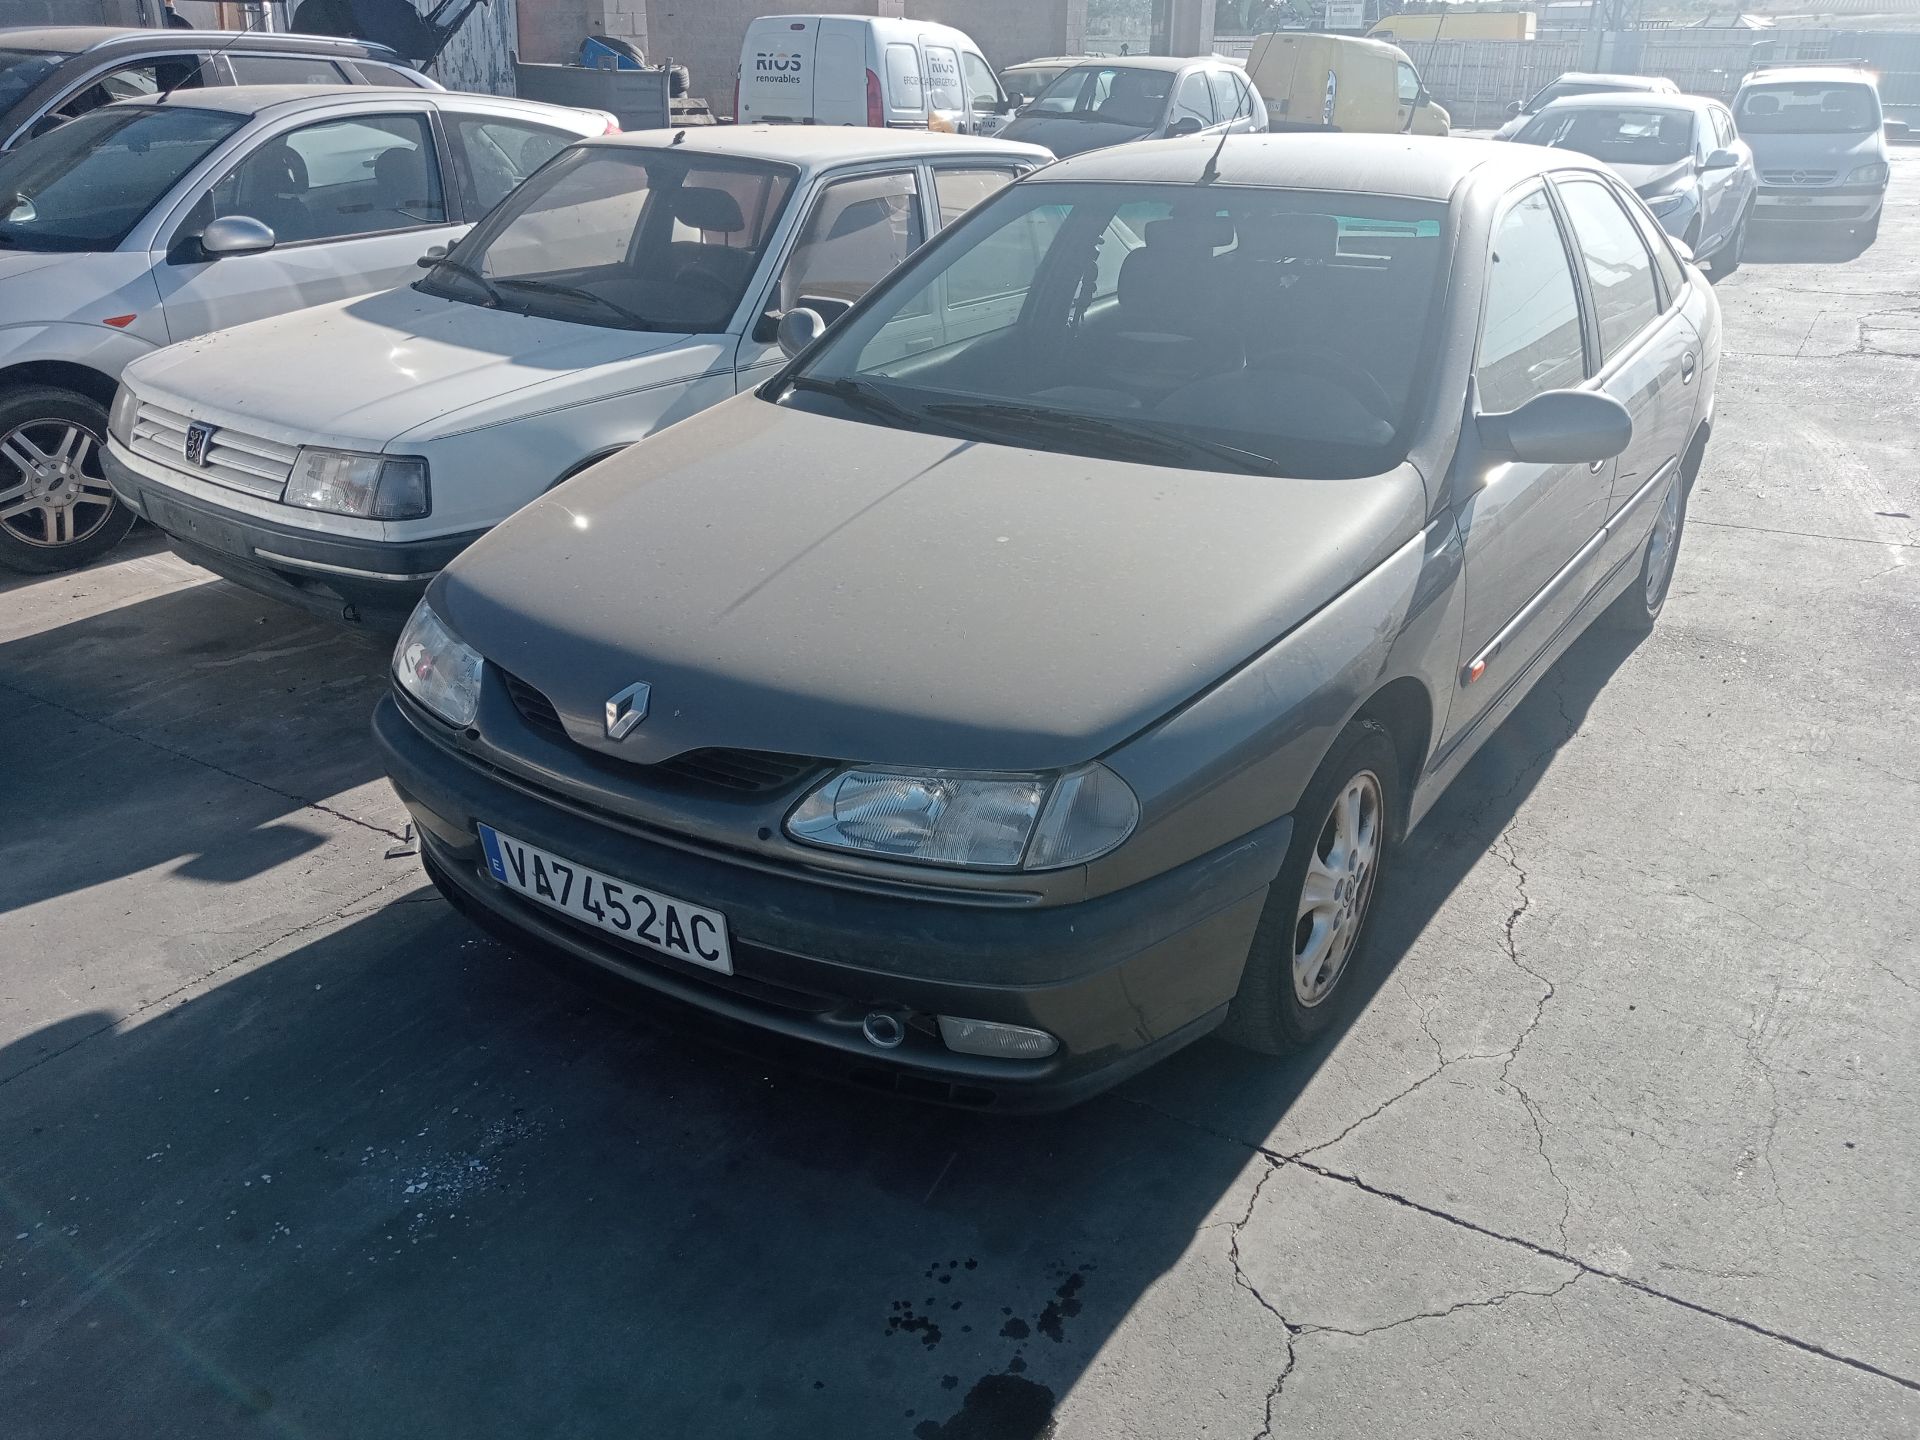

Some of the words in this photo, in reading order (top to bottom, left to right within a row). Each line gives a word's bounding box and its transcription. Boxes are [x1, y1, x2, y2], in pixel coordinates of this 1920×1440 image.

[756, 74, 801, 83] renovables
[493, 858, 501, 871] E
[504, 840, 719, 962] VA7452AC
